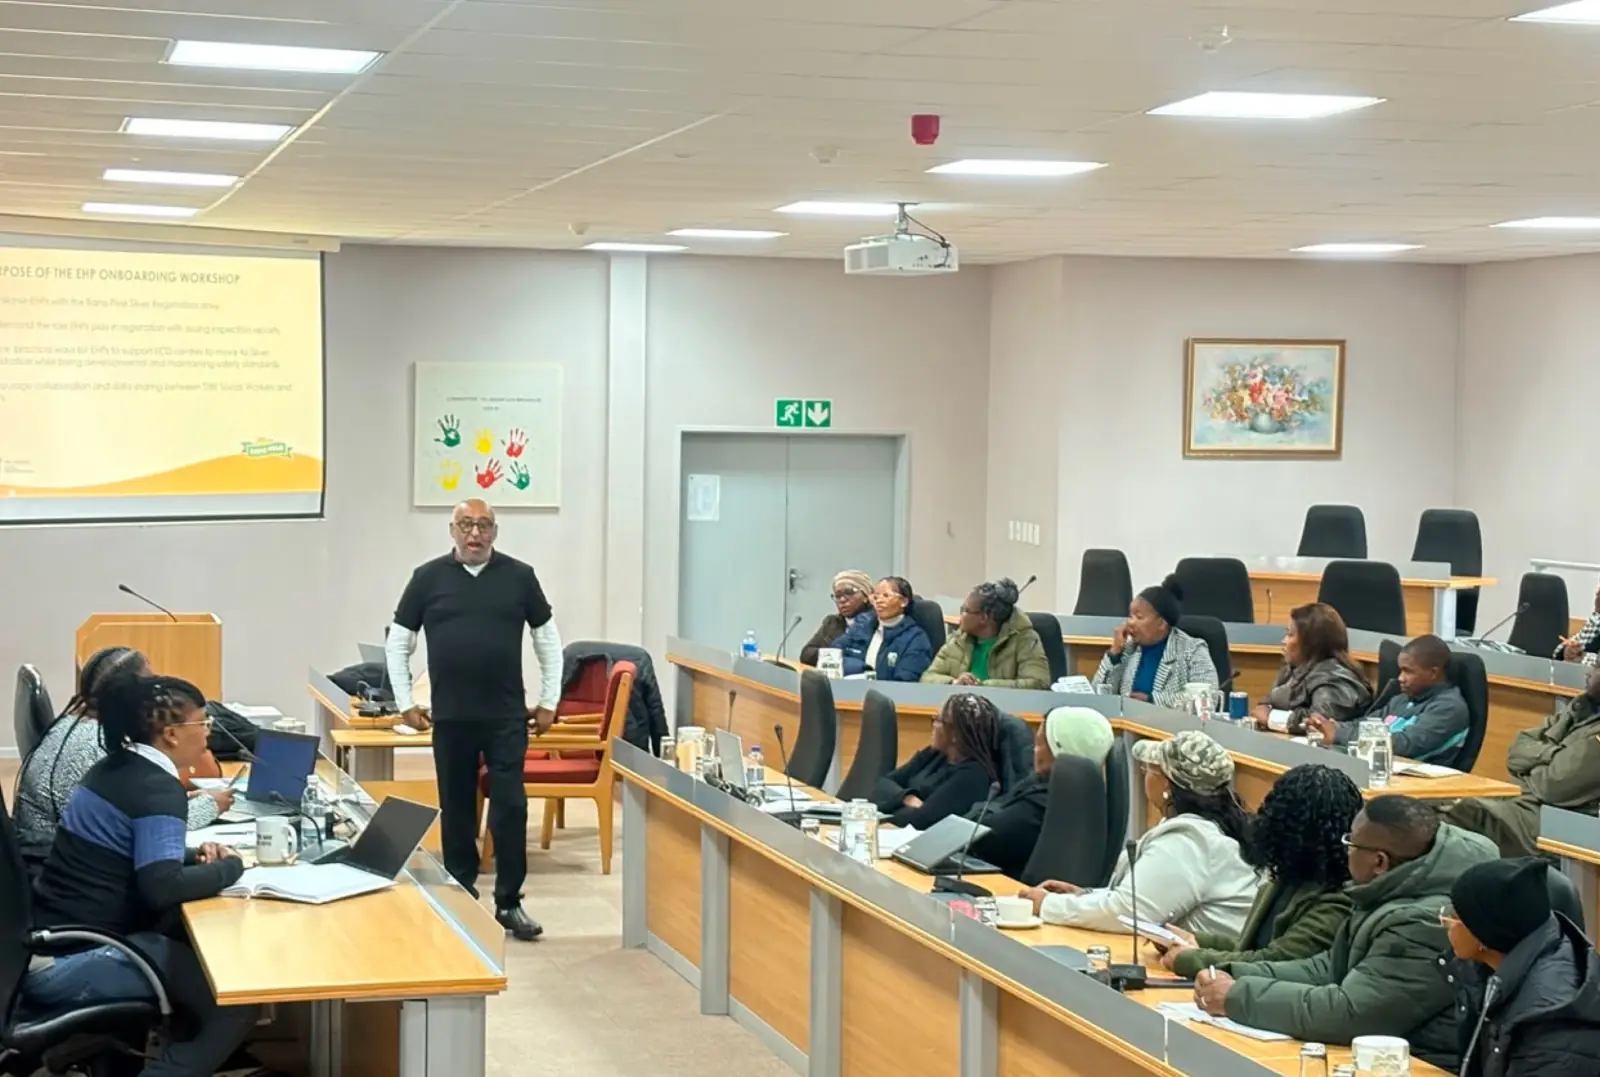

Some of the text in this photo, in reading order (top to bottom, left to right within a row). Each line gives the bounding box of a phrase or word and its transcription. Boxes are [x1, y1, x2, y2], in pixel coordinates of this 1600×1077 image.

[34, 266, 52, 280] OF
[54, 267, 73, 280] THE
[76, 269, 96, 281] EHP
[98, 269, 177, 283] ONBOARDING
[180, 271, 241, 285] WORKSHOP
